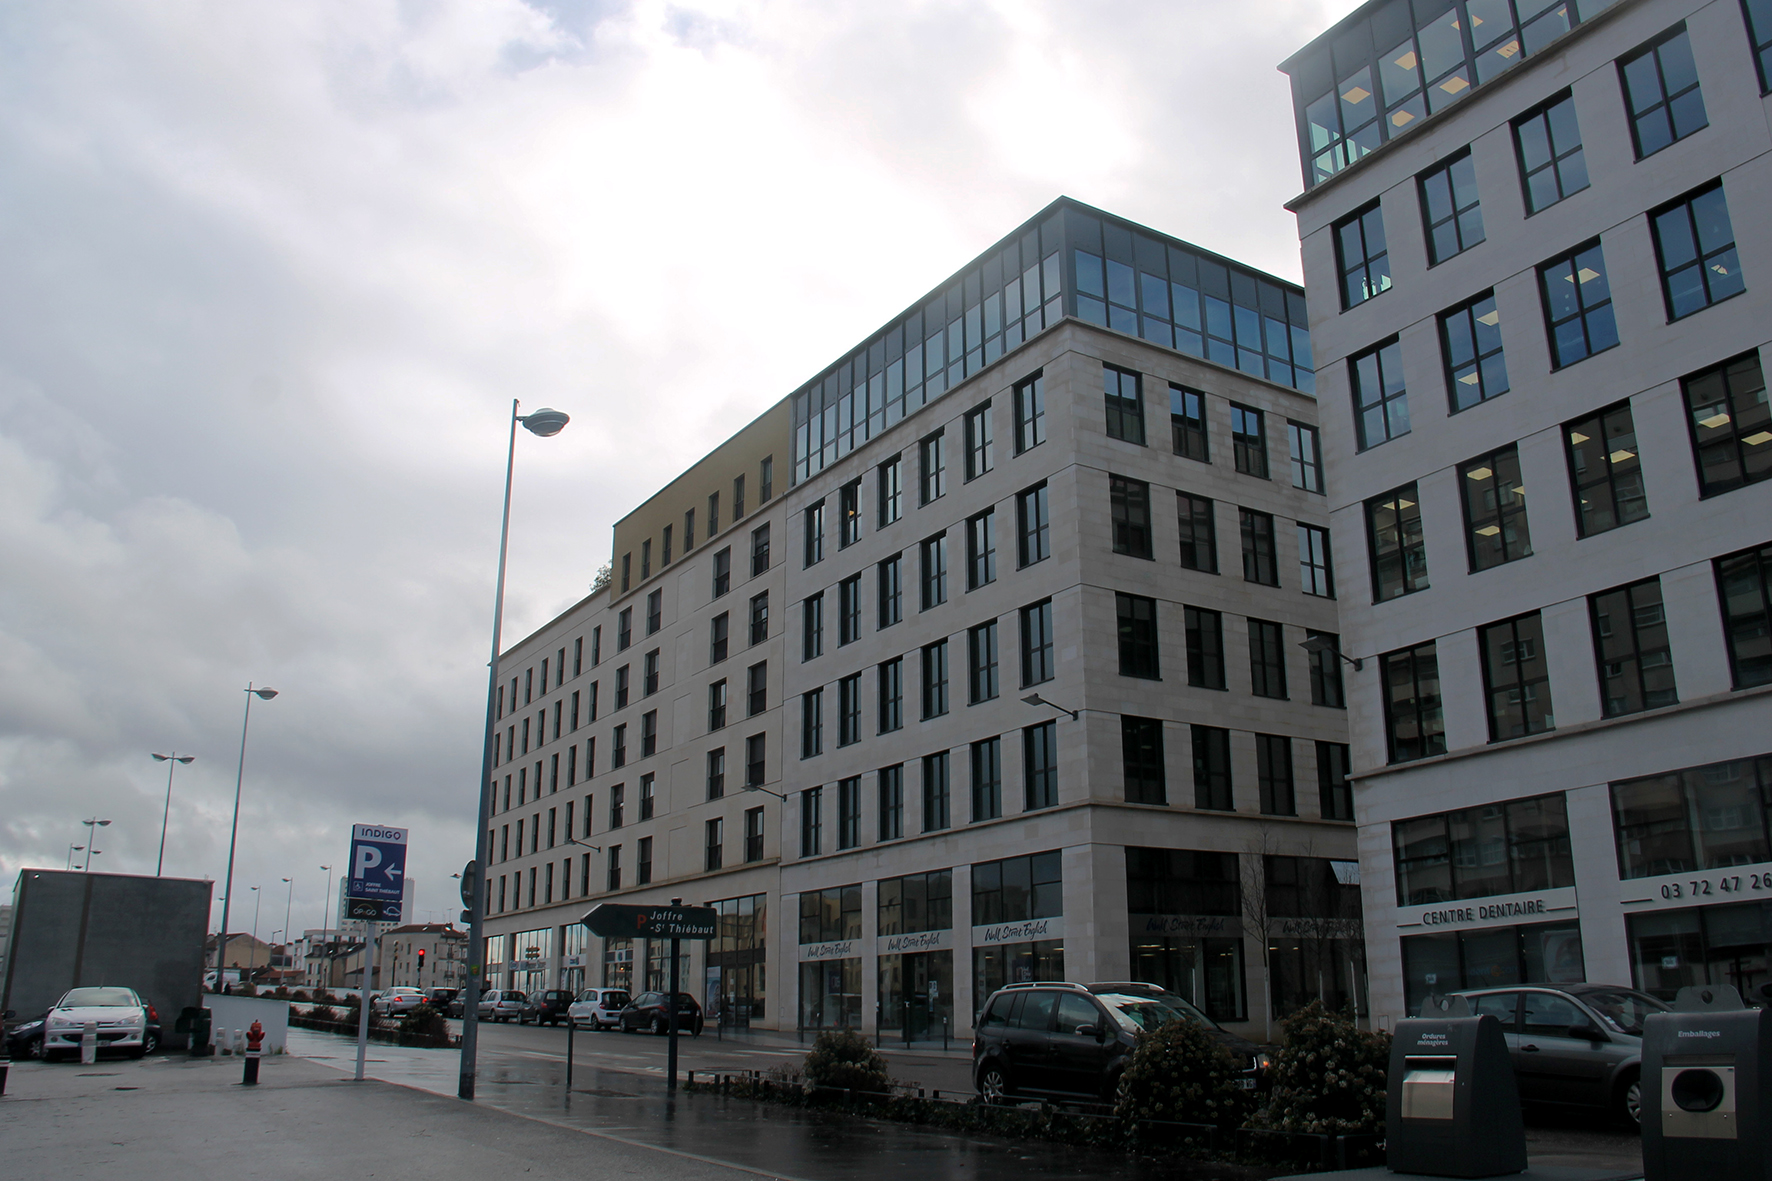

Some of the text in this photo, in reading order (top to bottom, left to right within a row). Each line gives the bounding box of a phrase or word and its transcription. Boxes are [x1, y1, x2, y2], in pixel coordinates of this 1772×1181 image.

[361, 828, 402, 841] INDIGO
[354, 844, 383, 879] P
[1661, 872, 1772, 899] 03 72 47 26
[650, 910, 683, 921] Joffre
[1422, 899, 1544, 925] CENTRE DENTAIRE
[637, 914, 647, 930] P
[669, 923, 714, 934] Thiébaut
[984, 926, 1002, 941] Wall
[1023, 920, 1048, 941] English
[1678, 1030, 1721, 1039] Emballages
[1417, 1039, 1449, 1047] ménagères
